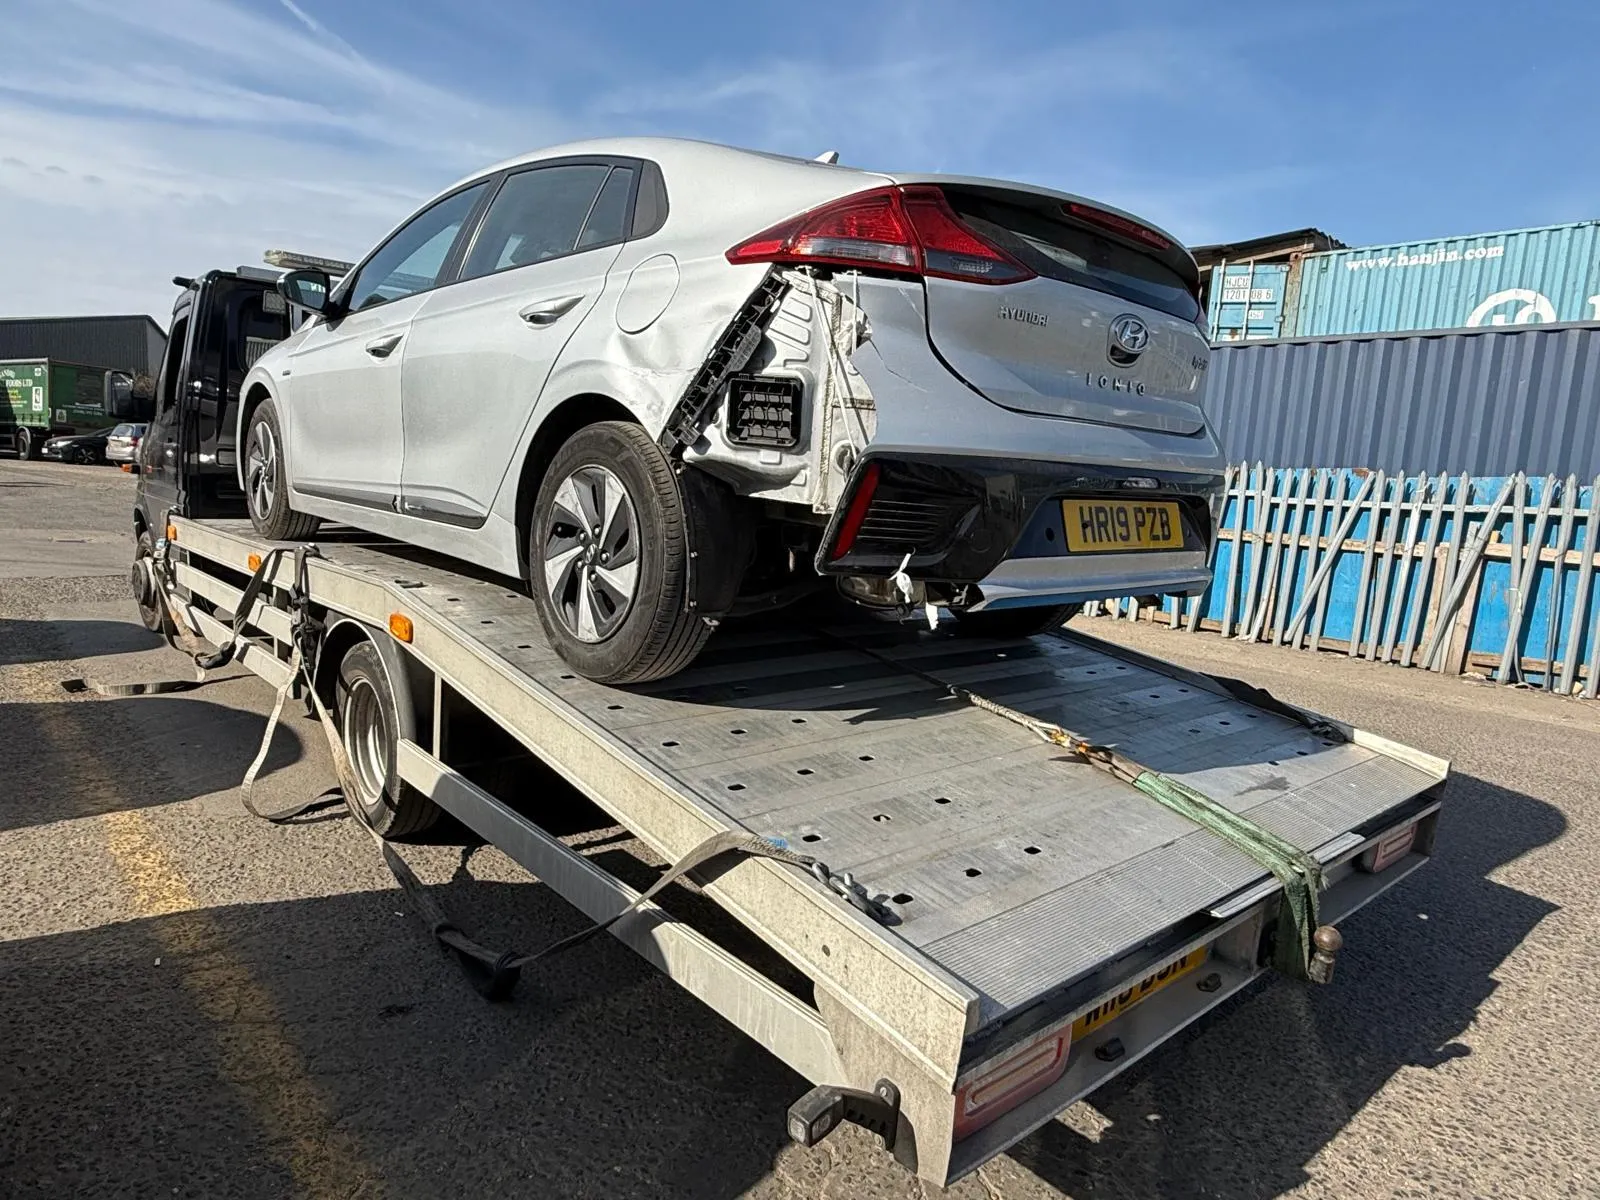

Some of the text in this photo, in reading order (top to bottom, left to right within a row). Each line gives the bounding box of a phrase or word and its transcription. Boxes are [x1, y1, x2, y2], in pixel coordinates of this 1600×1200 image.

[1345, 245, 1505, 271] www.hanjin.com
[1000, 306, 1049, 327] HYUNDAI
[22, 379, 33, 388] LTD
[1086, 372, 1146, 397] IONIQ
[1079, 505, 1172, 544] HR19 PZB
